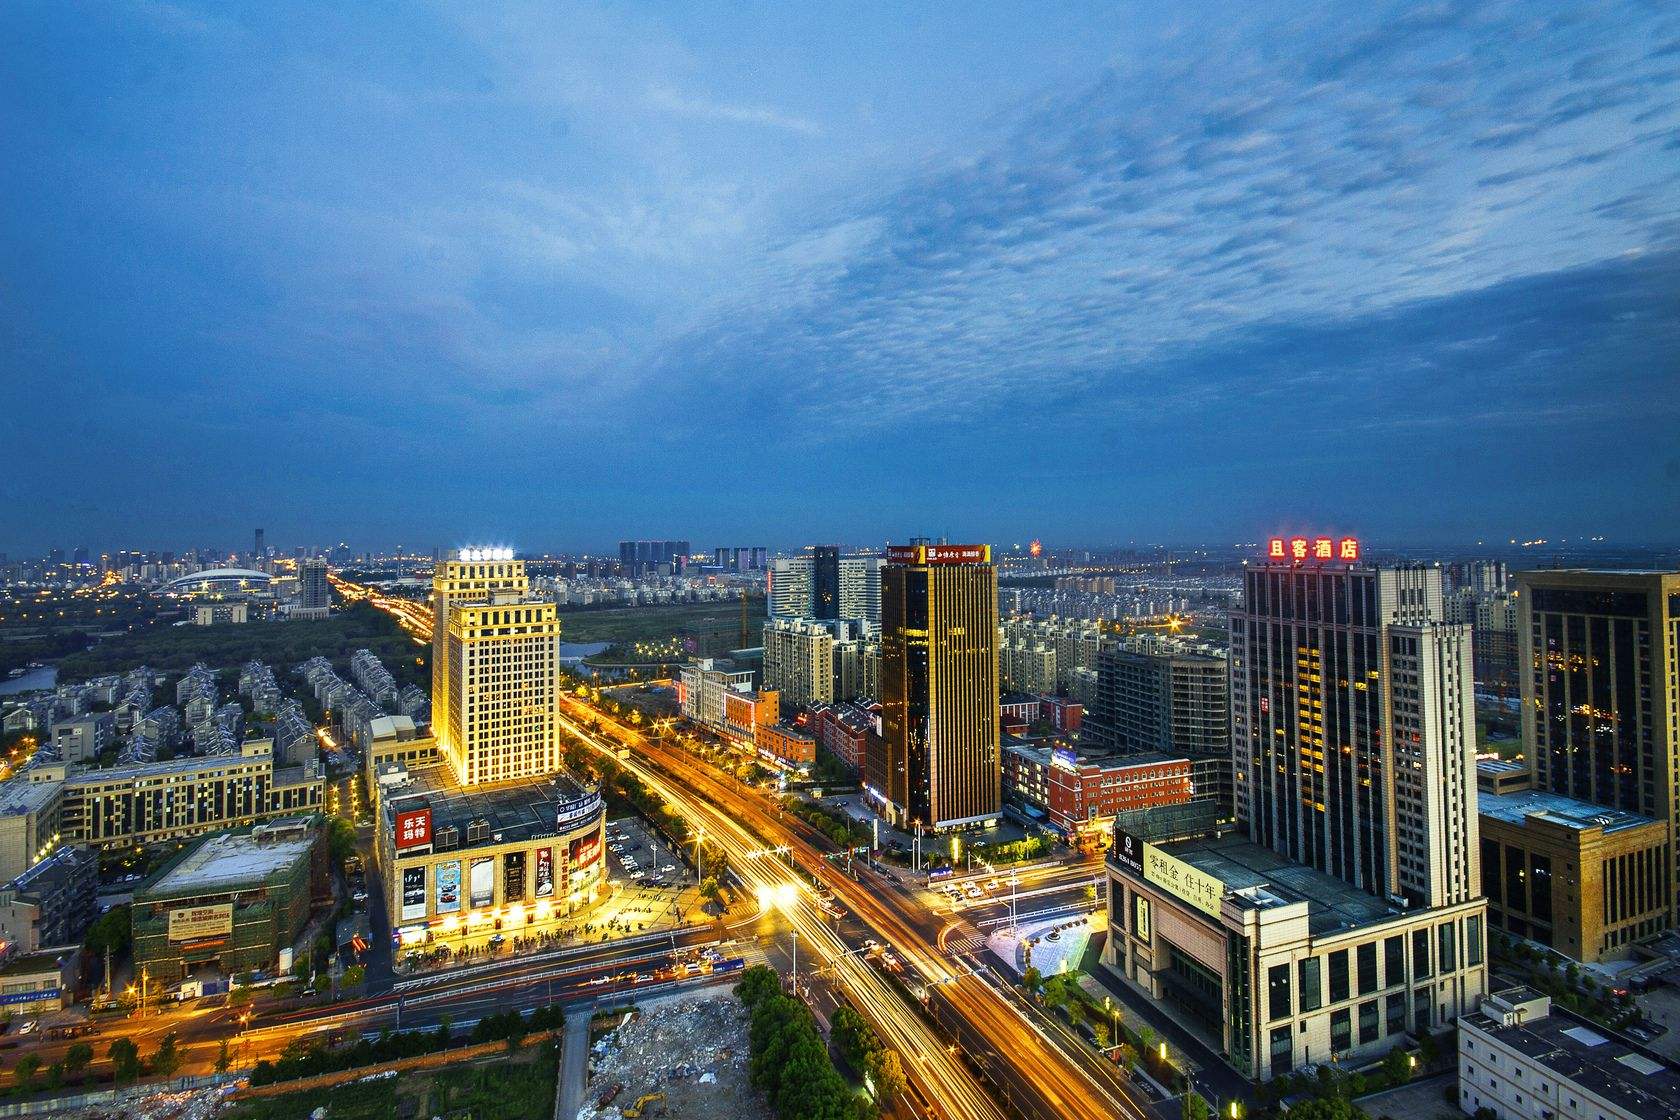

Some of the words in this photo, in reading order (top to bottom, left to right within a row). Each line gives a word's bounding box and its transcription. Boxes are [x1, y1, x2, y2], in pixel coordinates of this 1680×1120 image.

[1270, 539, 1357, 558] 且客酒店
[404, 816, 426, 829] 乐天
[403, 827, 426, 840] 玛特
[1184, 872, 1216, 900] 住十年
